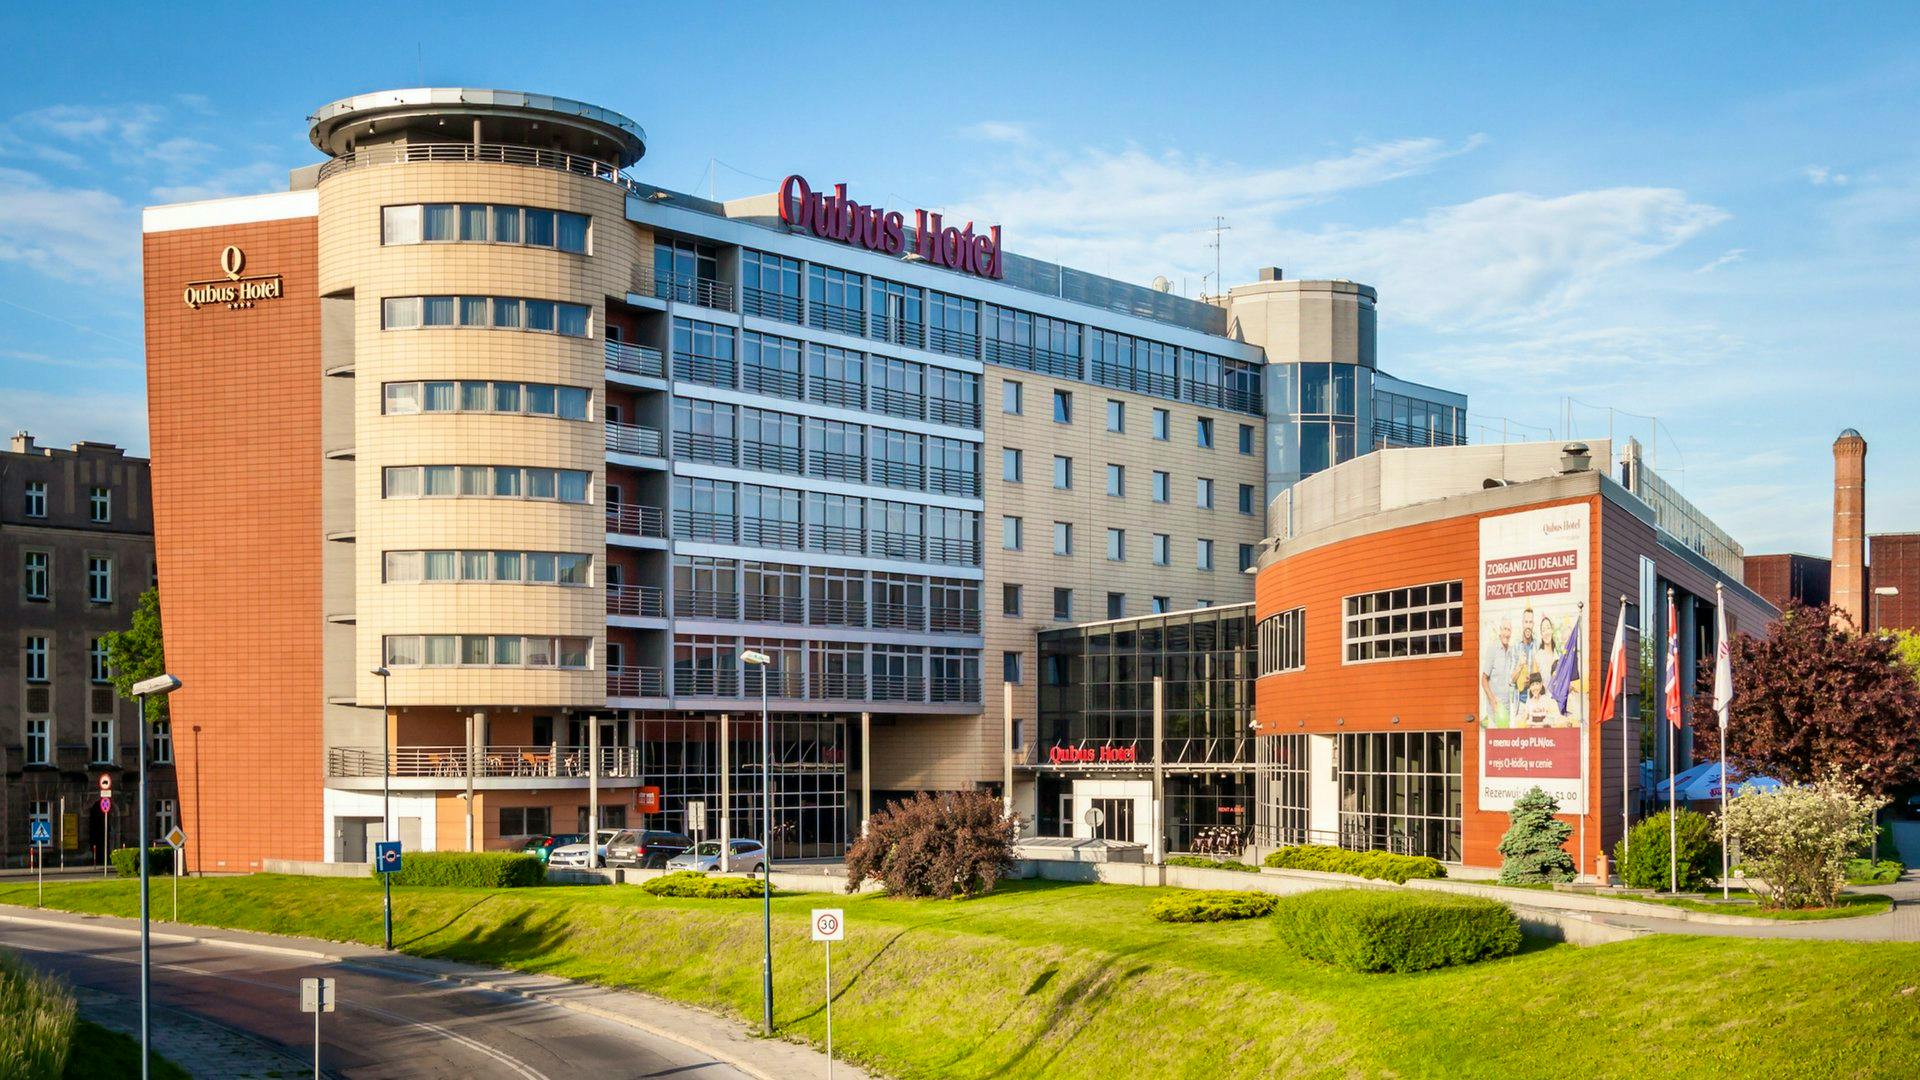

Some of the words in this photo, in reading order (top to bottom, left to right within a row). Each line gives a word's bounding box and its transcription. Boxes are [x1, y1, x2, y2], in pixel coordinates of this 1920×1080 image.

[778, 174, 906, 255] Qubus
[915, 208, 1003, 280] Hotel
[221, 245, 243, 282] Q
[183, 284, 235, 309] Qubus
[240, 278, 281, 300] Hotel
[1542, 522, 1562, 535] Qubus
[1563, 519, 1580, 531] Hotel
[1487, 559, 1537, 576] ZORGANIZUJ
[1538, 554, 1576, 569] IDEALNE
[1487, 582, 1525, 598] PRZYJĘCIE
[1525, 577, 1569, 592] RODZINNE
[1492, 739, 1511, 747] menu
[1511, 737, 1520, 747] od
[1050, 745, 1095, 764] Qubus
[1100, 745, 1136, 762] Hotel
[821, 919, 835, 930] 30
